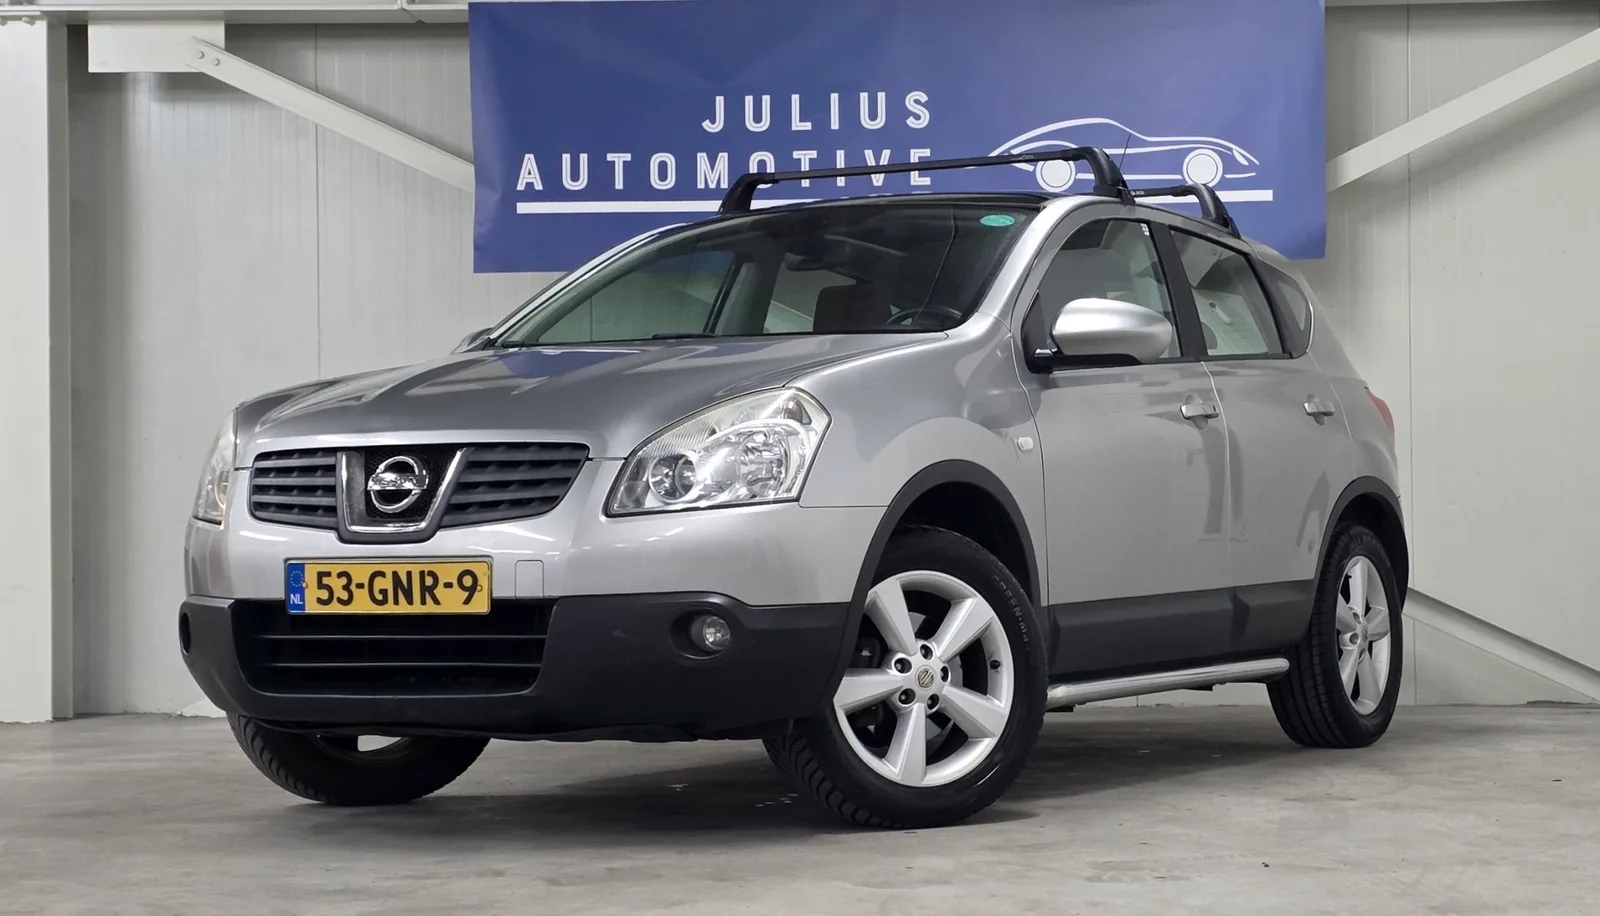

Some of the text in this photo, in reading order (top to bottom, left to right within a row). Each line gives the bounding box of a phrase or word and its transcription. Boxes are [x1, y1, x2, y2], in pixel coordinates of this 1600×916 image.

[701, 91, 931, 134] JULIUS
[516, 148, 933, 191] AUTOMOTIVE
[290, 593, 304, 605] NL
[315, 569, 480, 607] 53-GNR-9
